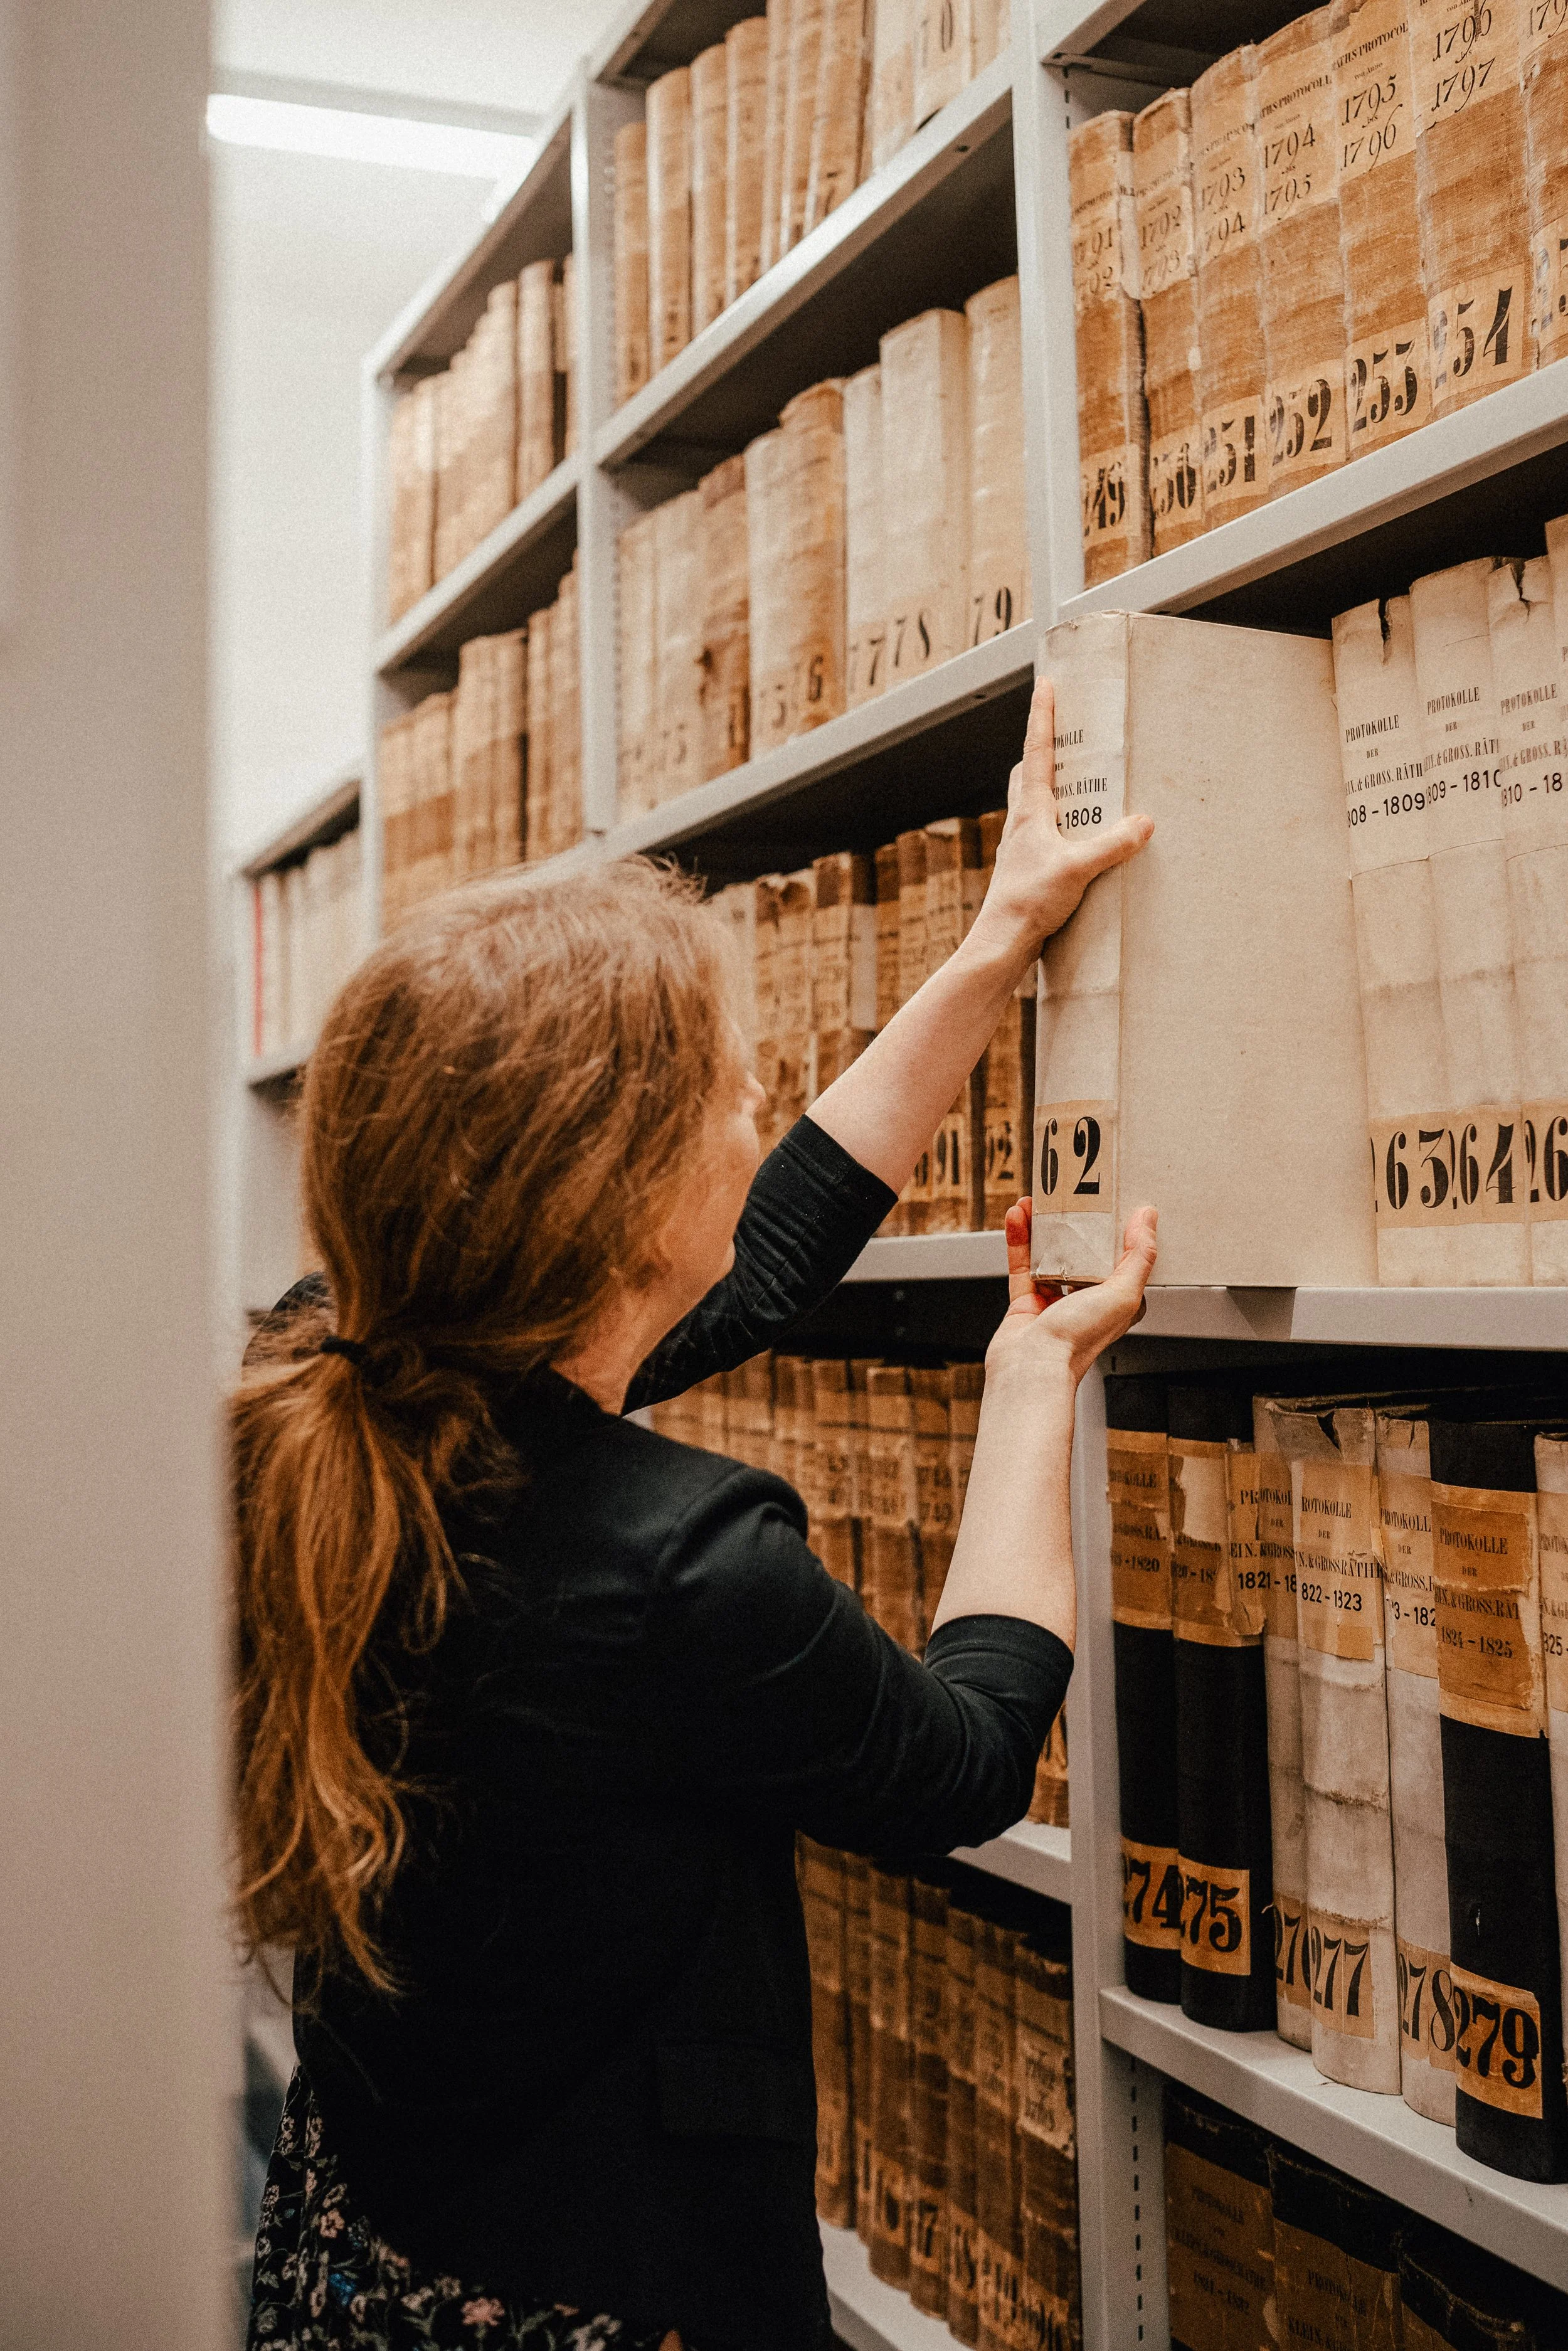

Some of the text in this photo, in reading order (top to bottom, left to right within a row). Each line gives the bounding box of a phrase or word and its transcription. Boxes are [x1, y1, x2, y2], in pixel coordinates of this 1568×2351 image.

[1342, 73, 1396, 125] 1795
[1431, 57, 1495, 113] 1797
[1340, 103, 1402, 171] 1796
[1351, 337, 1417, 433] 253
[1269, 378, 1332, 467] 252
[1427, 686, 1480, 716] PROTOKOLLE
[1500, 683, 1557, 715] PROTOKOLLE
[1345, 714, 1399, 743] PROTOKOLLE
[1445, 721, 1458, 732] DER
[1522, 720, 1535, 731] DER
[1366, 748, 1379, 759] DER
[1443, 743, 1473, 764] GROSS.
[1364, 768, 1394, 789] GROSS.
[1383, 792, 1426, 817] 1809
[1041, 1116, 1101, 1196] 62
[1370, 1128, 1449, 1213] 63
[1318, 1529, 1331, 1539] DER
[1439, 1527, 1508, 1556] PROTOKOLLE
[1398, 1544, 1411, 1554] DER
[1237, 1570, 1271, 1590] 1821
[1462, 1566, 1478, 1578] DER
[1480, 1635, 1513, 1658] 1825
[1311, 1926, 1369, 2017] 277
[1453, 1985, 1540, 2089] 279
